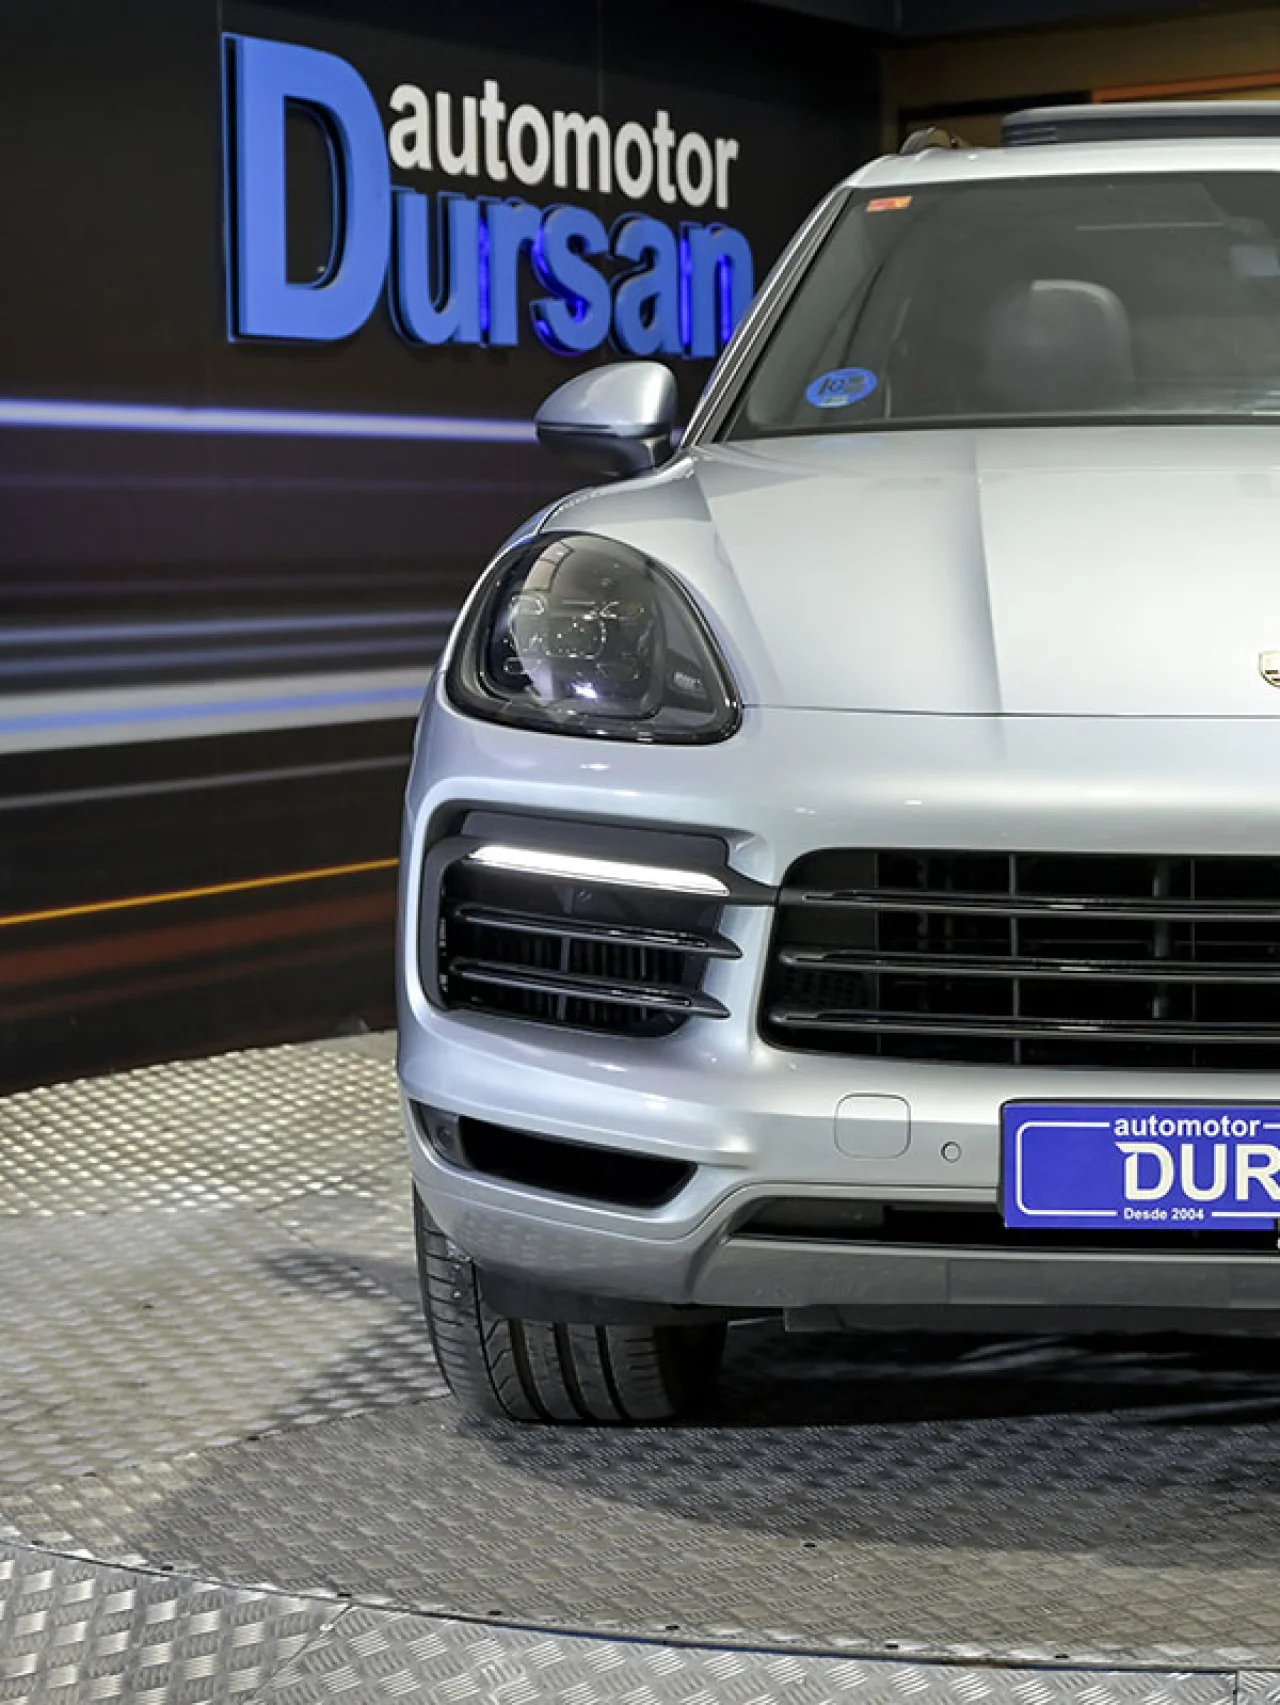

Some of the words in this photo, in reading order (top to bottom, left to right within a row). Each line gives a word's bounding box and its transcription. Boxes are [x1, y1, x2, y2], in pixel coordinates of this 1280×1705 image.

[388, 79, 738, 208] automotor
[221, 32, 753, 359] Dursan
[1114, 1115, 1261, 1137] automotor
[1123, 1207, 1168, 1220] Desde
[1171, 1207, 1204, 1220] 2004
